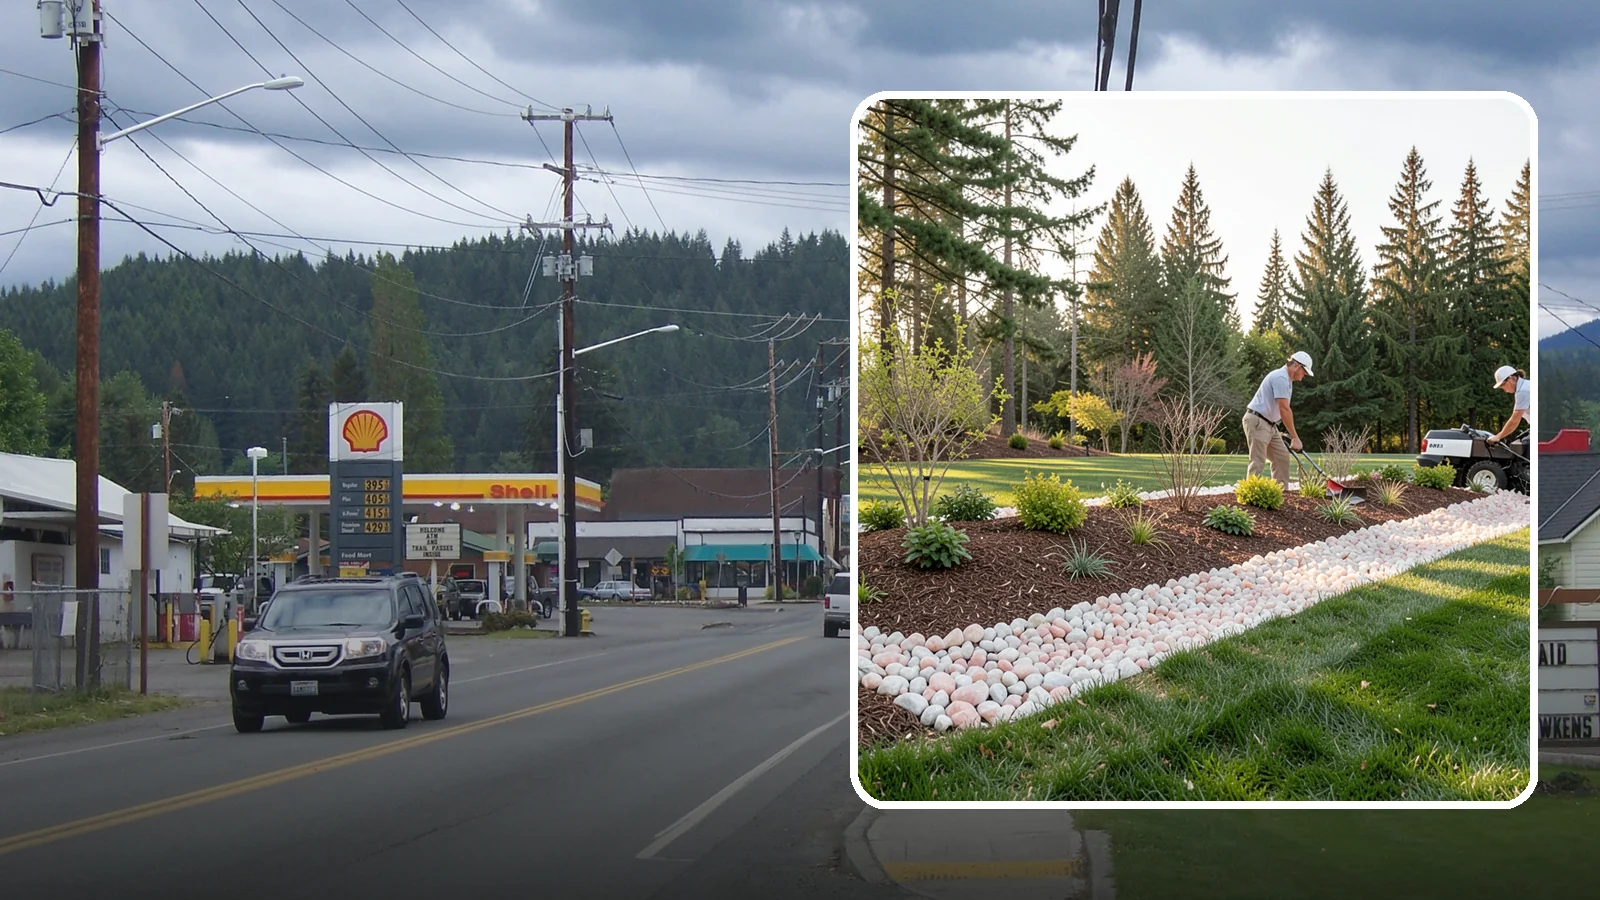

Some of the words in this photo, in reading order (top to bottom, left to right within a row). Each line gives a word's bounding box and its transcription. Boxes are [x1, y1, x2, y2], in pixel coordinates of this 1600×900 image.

[366, 480, 383, 490] 395
[490, 484, 547, 499] Shell
[366, 494, 383, 504] 405
[366, 508, 383, 518] 415
[366, 522, 383, 532] 429
[1538, 643, 1566, 665] AID
[1538, 715, 1592, 739] WKENS
